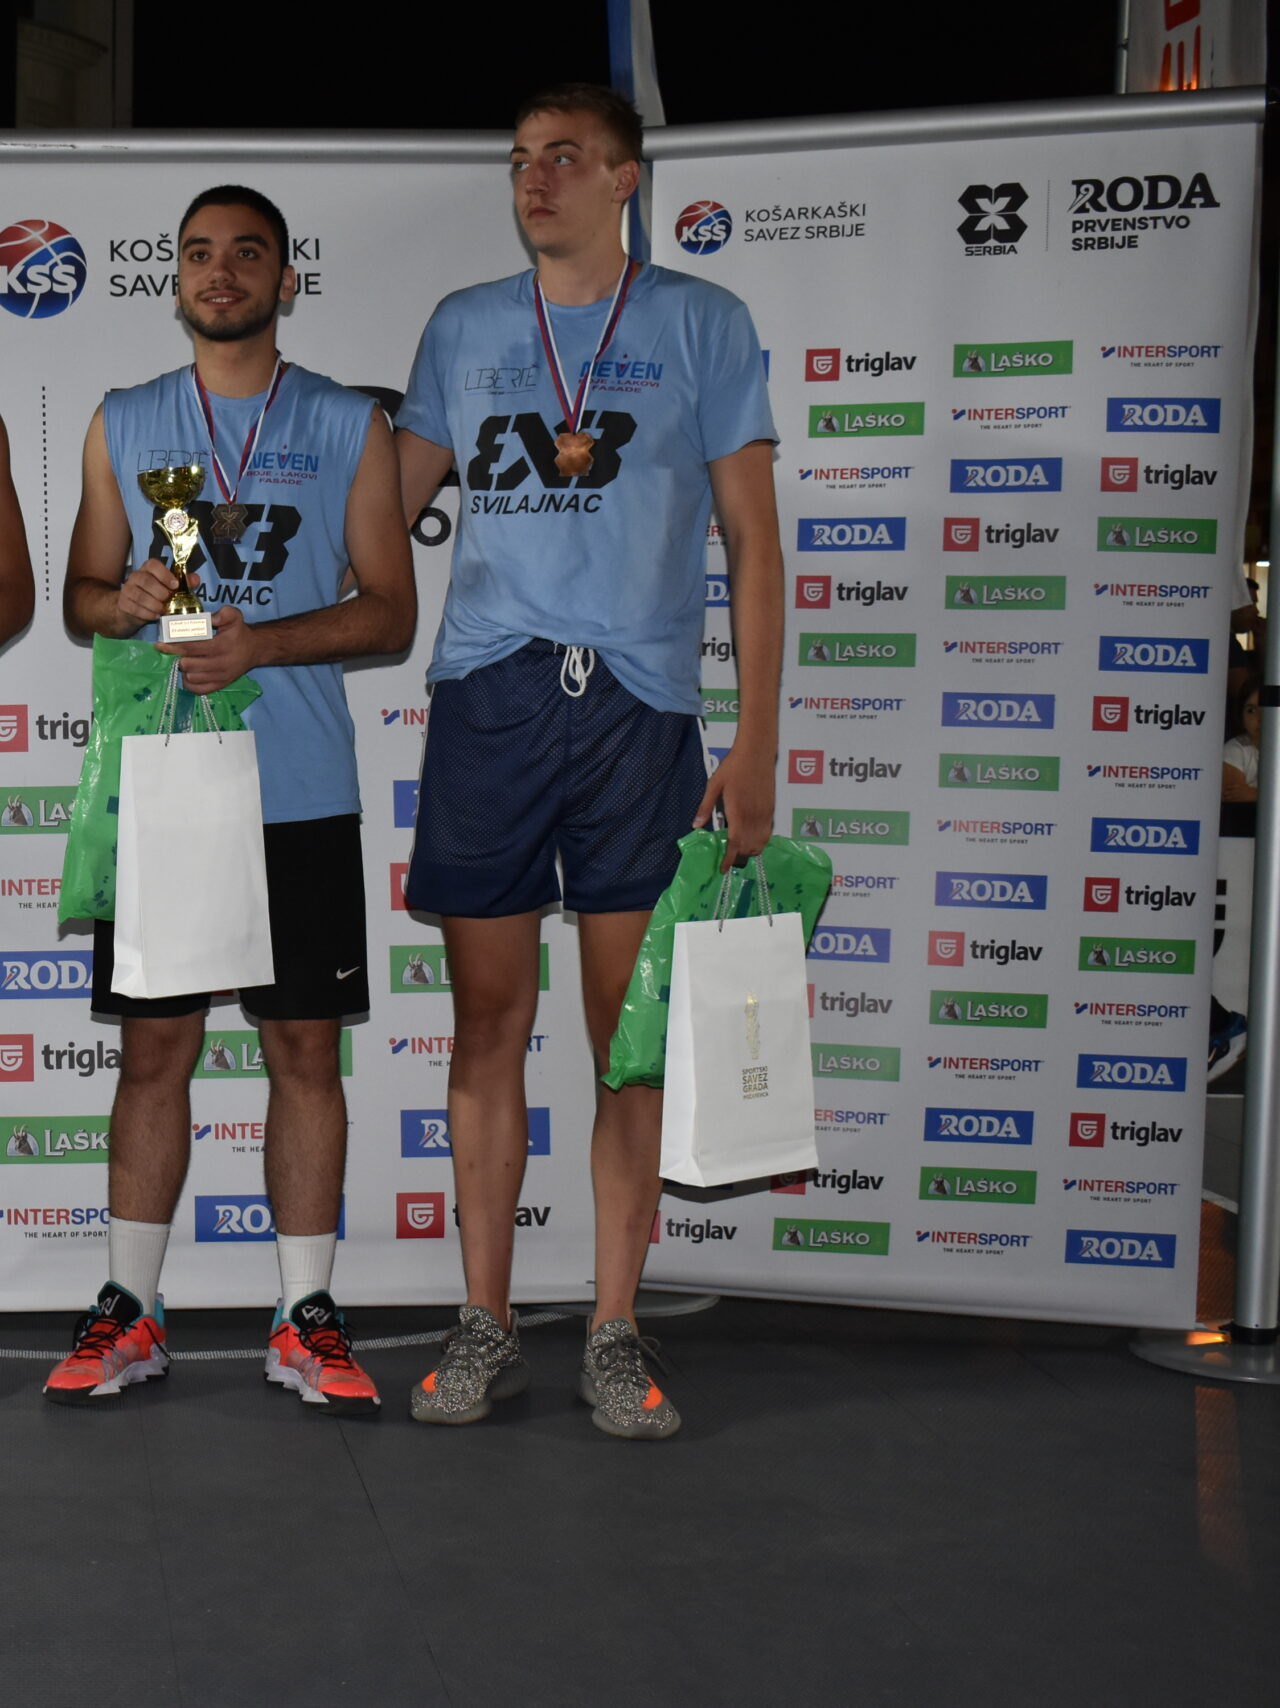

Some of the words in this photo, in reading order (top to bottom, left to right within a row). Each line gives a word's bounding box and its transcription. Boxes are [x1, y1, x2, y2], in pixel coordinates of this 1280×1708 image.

[1069, 173, 1220, 214] RODA
[746, 202, 865, 223] KOŠARKAŠKI
[681, 222, 729, 243] KSS
[744, 230, 800, 242] SAVEZ
[805, 223, 864, 239] SRBIJE
[1072, 216, 1190, 233] PRVENSTVO
[965, 245, 1017, 256] SERBIA
[1072, 235, 1138, 251] SRBIJE
[1118, 345, 1220, 358] INTERSPORT
[579, 360, 664, 381] NEVEN
[846, 352, 916, 377] triglav
[991, 353, 1053, 372] LAŠKO
[845, 414, 904, 431] LAŠKO
[968, 406, 1068, 420] INTERSPORT
[1123, 405, 1207, 425] RODA
[814, 467, 910, 480] INTERSPORT
[966, 465, 1048, 486] RODA
[1144, 464, 1217, 490] triglav
[470, 494, 603, 515] SVILAJNAC
[813, 524, 892, 545] RODA
[985, 523, 1059, 548] triglav
[1135, 527, 1197, 546] LAŠKO
[837, 581, 908, 606] triglav
[983, 585, 1045, 604] LAŠKO
[1110, 584, 1209, 598] INTERSPORT
[835, 643, 896, 661] LAŠKO
[960, 642, 1061, 654] INTERSPORT
[1115, 644, 1196, 666] RODA
[804, 698, 903, 710] INTERSPORT
[957, 700, 1041, 721] RODA
[1135, 704, 1205, 730] triglav
[36, 712, 89, 747] trig
[829, 757, 901, 782] triglav
[976, 764, 1039, 783] LAŠKO
[1103, 766, 1202, 780] INTERSPORT
[828, 819, 889, 837] LAŠKO
[954, 822, 1053, 835] INTERSPORT
[1104, 825, 1187, 848] RODA
[951, 879, 1033, 902] RODA
[1125, 885, 1196, 911] triglav
[813, 933, 877, 957] ODA
[971, 940, 1042, 965] triglav
[1115, 947, 1176, 966] LAŠKO
[820, 992, 892, 1017] triglav
[967, 1001, 1027, 1020] LAŠKO
[1090, 1003, 1187, 1018] INTERSPORT
[42, 1041, 121, 1077] trigla
[819, 1053, 880, 1072] LAŠKO
[944, 1057, 1042, 1072] INTERSPORT
[742, 1073, 768, 1084] SAVEZ
[1090, 1062, 1173, 1084] RODA
[937, 1115, 1020, 1138] RODA
[1111, 1121, 1183, 1146] triglav
[44, 1129, 109, 1157] LAŠK
[813, 1168, 884, 1194] triglav
[956, 1177, 1016, 1195] LAŠKO
[1078, 1180, 1175, 1195] INTERSPORT
[24, 1231, 38, 1239] THE
[42, 1231, 68, 1239] HEART
[70, 1231, 79, 1239] OF
[82, 1231, 108, 1239] SPORT
[666, 1218, 737, 1243] triglav
[809, 1229, 869, 1246] LAŠKO
[931, 1231, 1030, 1247] INTERSPORT
[1081, 1237, 1162, 1261] RODA
